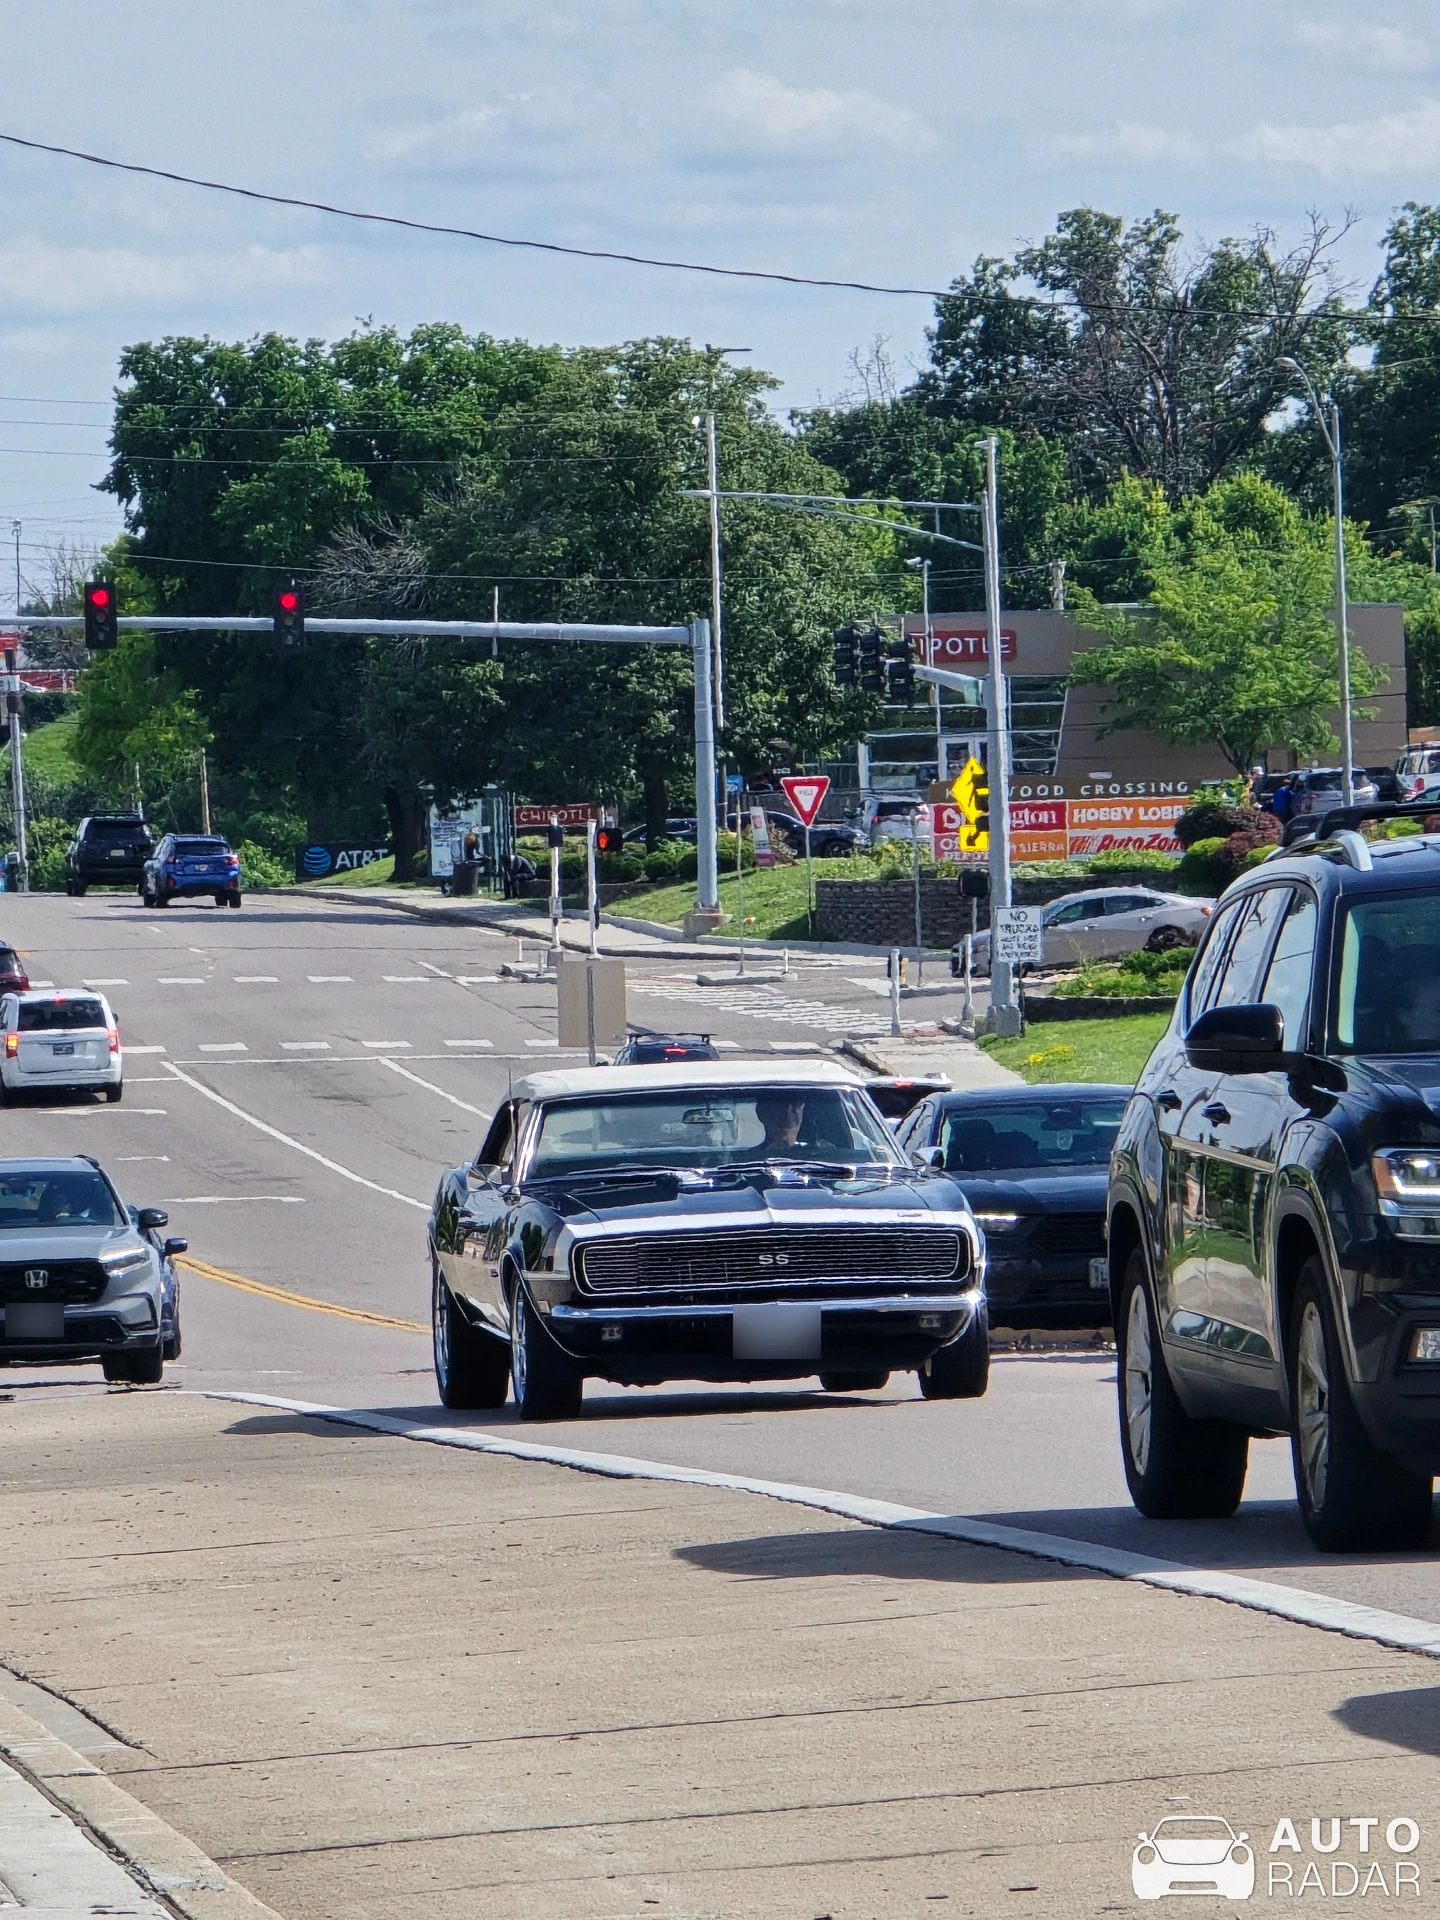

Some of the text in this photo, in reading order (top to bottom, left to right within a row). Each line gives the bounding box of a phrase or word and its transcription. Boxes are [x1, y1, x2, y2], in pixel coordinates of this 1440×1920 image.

[1080, 782, 1188, 796] CROSSING
[1073, 805, 1186, 824] HOBBY LOBB
[1020, 841, 1065, 853] SIERRA
[1096, 833, 1186, 853] AutoZon
[1010, 911, 1028, 922] NO
[999, 923, 1040, 934] TRUCKS
[758, 1254, 790, 1265] SS
